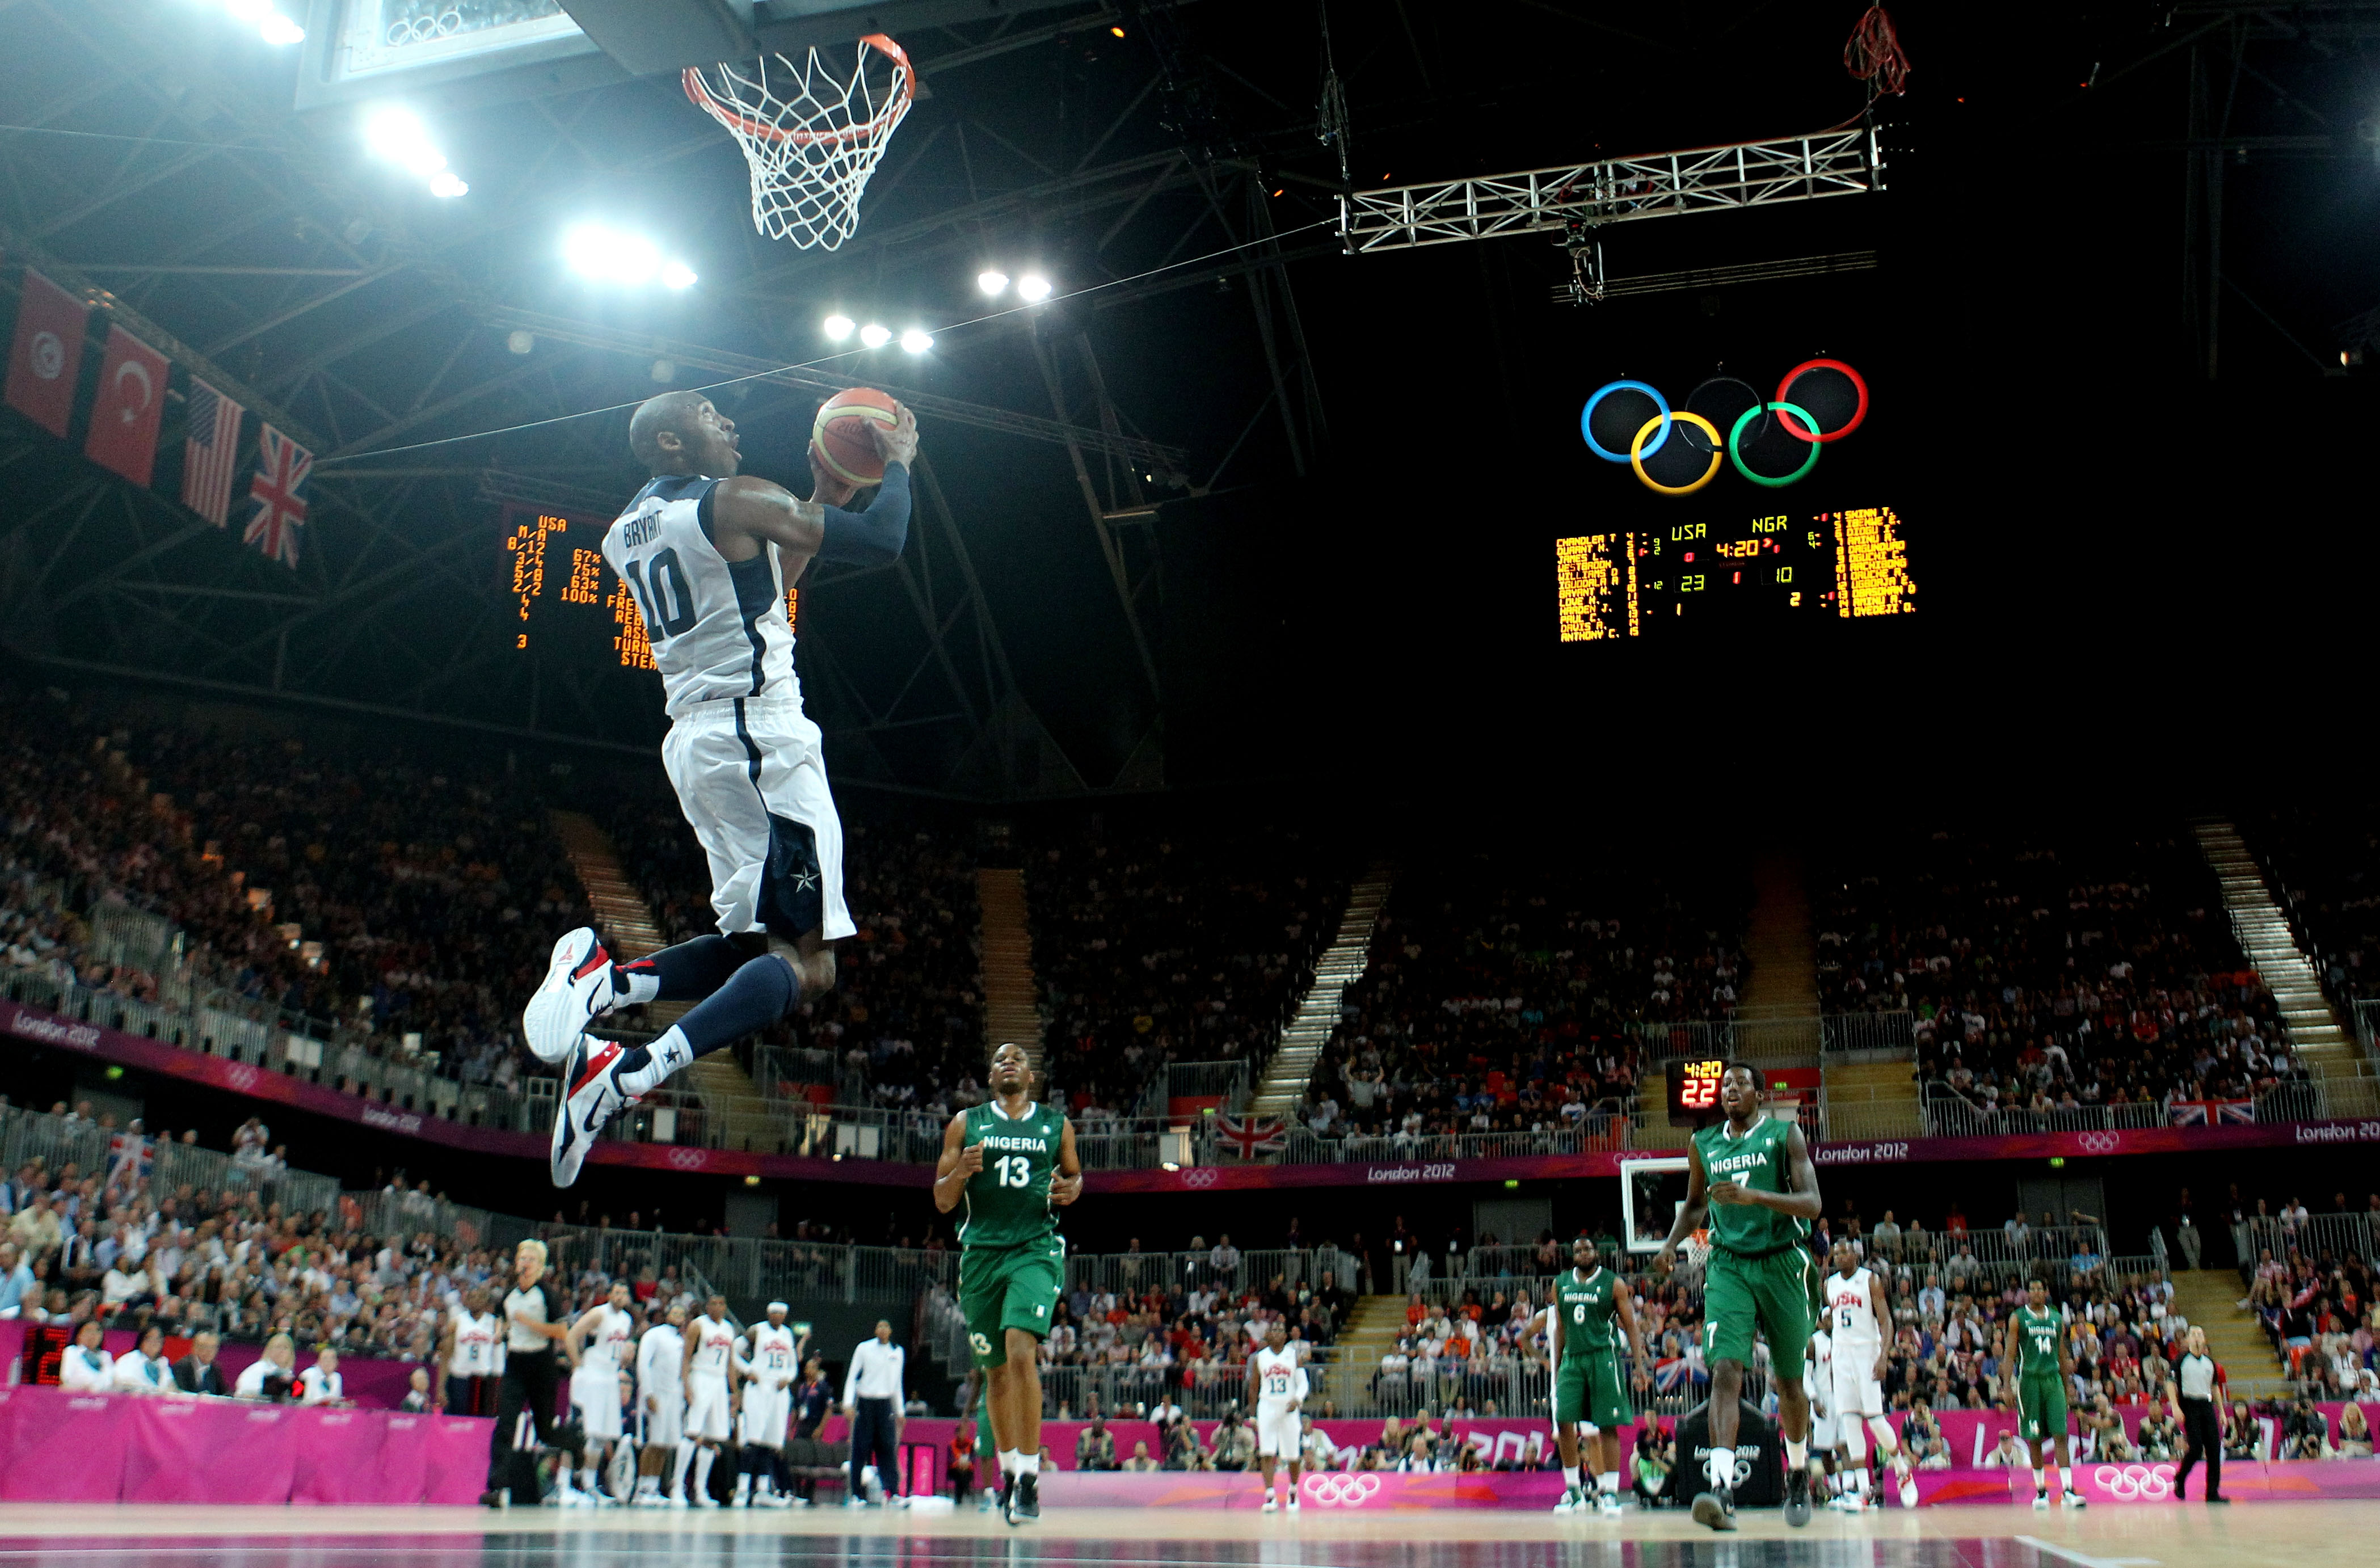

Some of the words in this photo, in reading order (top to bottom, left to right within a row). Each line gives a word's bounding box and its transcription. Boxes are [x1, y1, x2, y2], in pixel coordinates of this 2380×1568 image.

[538, 515, 567, 533] USA
[624, 510, 663, 548] BRYANT
[1672, 523, 1706, 541] USA
[1753, 515, 1787, 533] NGR
[518, 525, 547, 542] M/A
[1557, 534, 1604, 547] CHANDLER
[507, 536, 546, 555] 8/12
[1557, 545, 1593, 555] DURANT
[1717, 539, 1759, 558] 4:20
[515, 551, 544, 568] 3/4
[573, 548, 601, 564] 67%
[1557, 554, 1587, 564] JAMES
[514, 565, 544, 581] 5/8
[572, 562, 600, 577] 75%
[1558, 560, 1611, 572] WESTBROOK
[1558, 568, 1606, 581] WILLIAMS
[1776, 567, 1792, 583] 10
[512, 579, 542, 596] 2/2
[570, 575, 600, 591] 63%
[1558, 578, 1606, 590] IGUODALA
[1654, 581, 1663, 590] 12
[1681, 575, 1704, 592] 23
[521, 593, 530, 607] 4
[561, 587, 598, 604] 100%
[625, 547, 698, 643] 10
[1559, 587, 1595, 598] BRYANT
[1790, 592, 1801, 606] 2
[1560, 597, 1583, 607] LOVE
[1560, 604, 1596, 616] HARDEN
[519, 607, 529, 621] 4
[1560, 614, 1584, 625] PAUL
[1561, 622, 1591, 633] DAVIS
[517, 634, 528, 648] 3
[1561, 630, 1603, 642] ANTHONY
[1684, 1061, 1722, 1078] 4:20
[1682, 1079, 1716, 1104] 22
[2296, 1121, 2355, 1144] London
[983, 1136, 1047, 1153] NIGERIA
[1815, 1144, 1870, 1163] London
[1874, 1142, 1909, 1161] 2012
[994, 1155, 1030, 1188] 13
[1710, 1152, 1767, 1175] NIGERIA
[1367, 1165, 1419, 1182] London
[1422, 1163, 1455, 1179] 2012
[1732, 1170, 1750, 1188] 7
[1564, 1292, 1598, 1304] NIGERIA
[1832, 1292, 1862, 1309] USA
[1574, 1304, 1585, 1324] 6
[1842, 1308, 1851, 1327] 5
[1707, 1321, 1717, 1348] 7
[2028, 1326, 2057, 1338] NIGERIA
[2035, 1335, 2052, 1355] 14
[1270, 1379, 1286, 1393] 13
[1735, 1445, 1760, 1461] 2012
